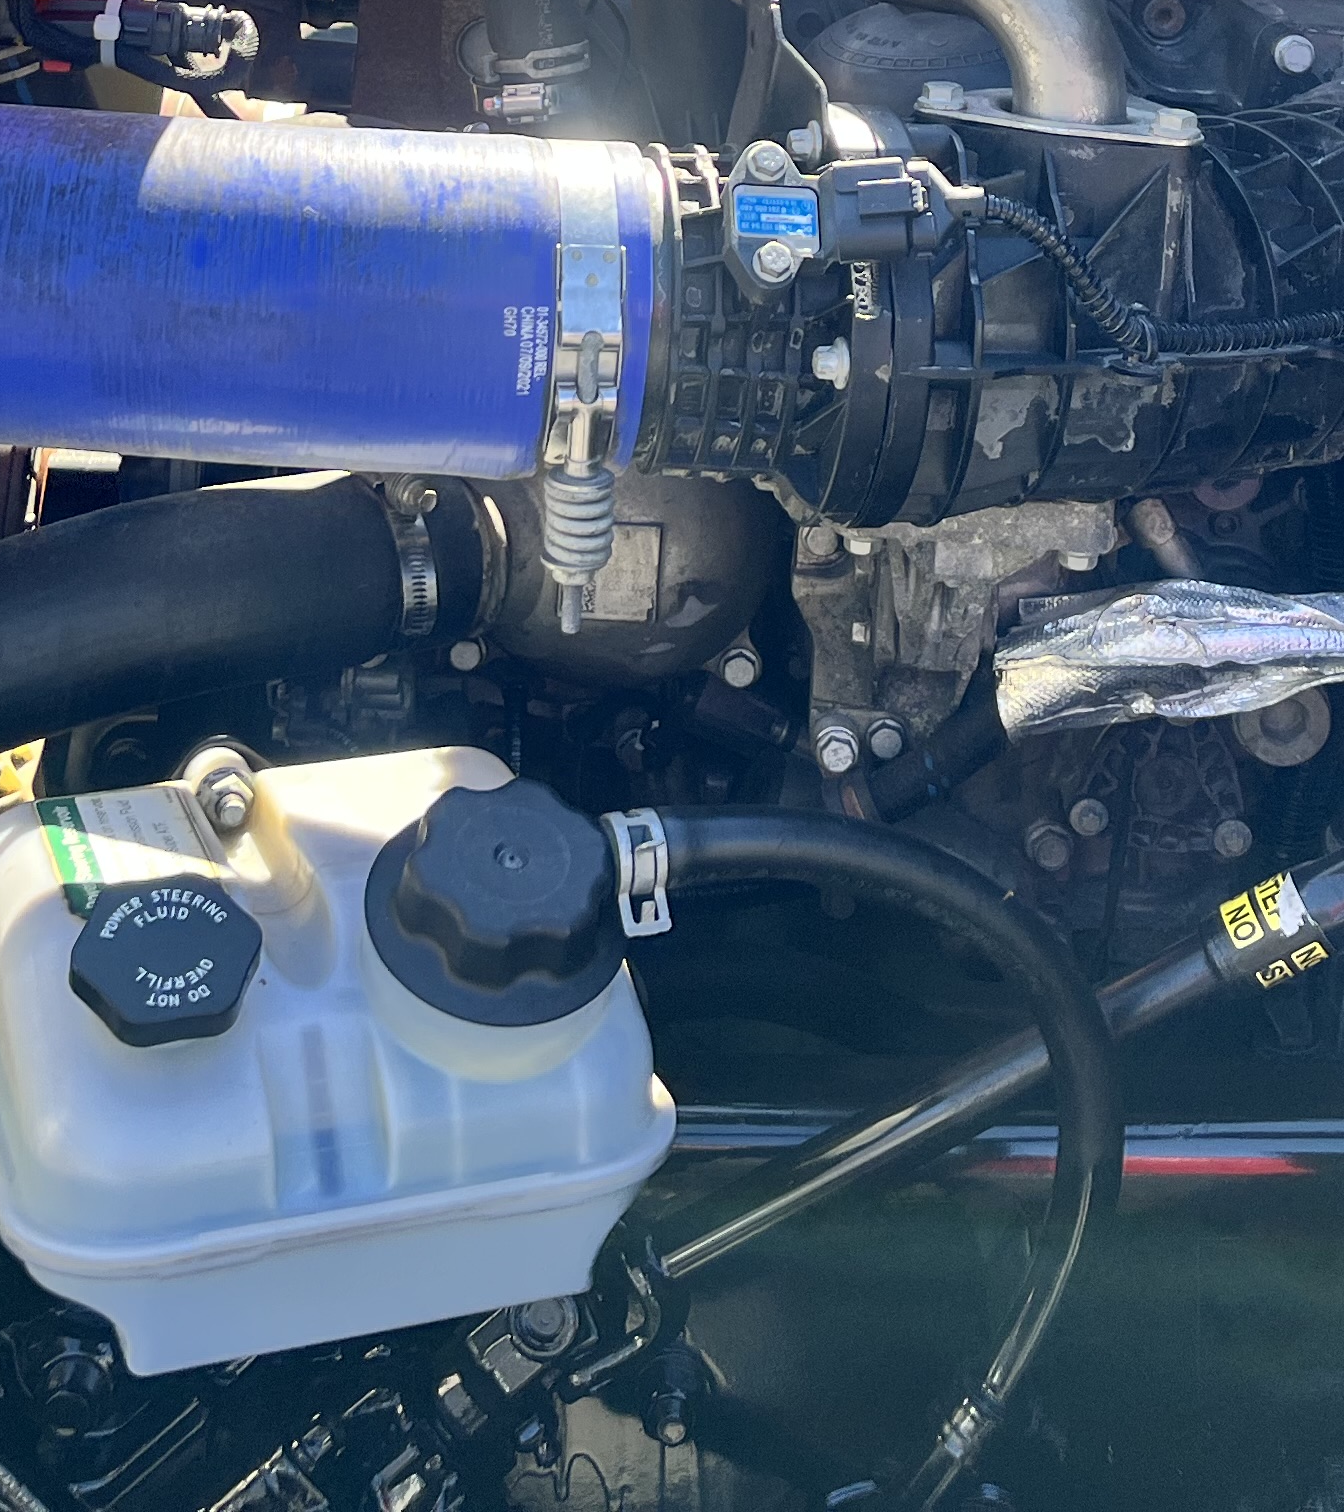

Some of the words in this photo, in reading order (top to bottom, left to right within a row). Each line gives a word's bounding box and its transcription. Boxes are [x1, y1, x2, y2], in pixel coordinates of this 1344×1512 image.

[503, 306, 517, 337] GH70
[520, 306, 535, 340] CHINA
[516, 341, 533, 396] 07/09/2021
[99, 896, 143, 940] POWER
[150, 888, 229, 924] STEERING
[133, 905, 189, 929] FLUID
[1224, 903, 1257, 941] NO
[135, 958, 214, 992] OVERFILL
[146, 992, 180, 1008] NOT
[187, 984, 212, 1003] DO
